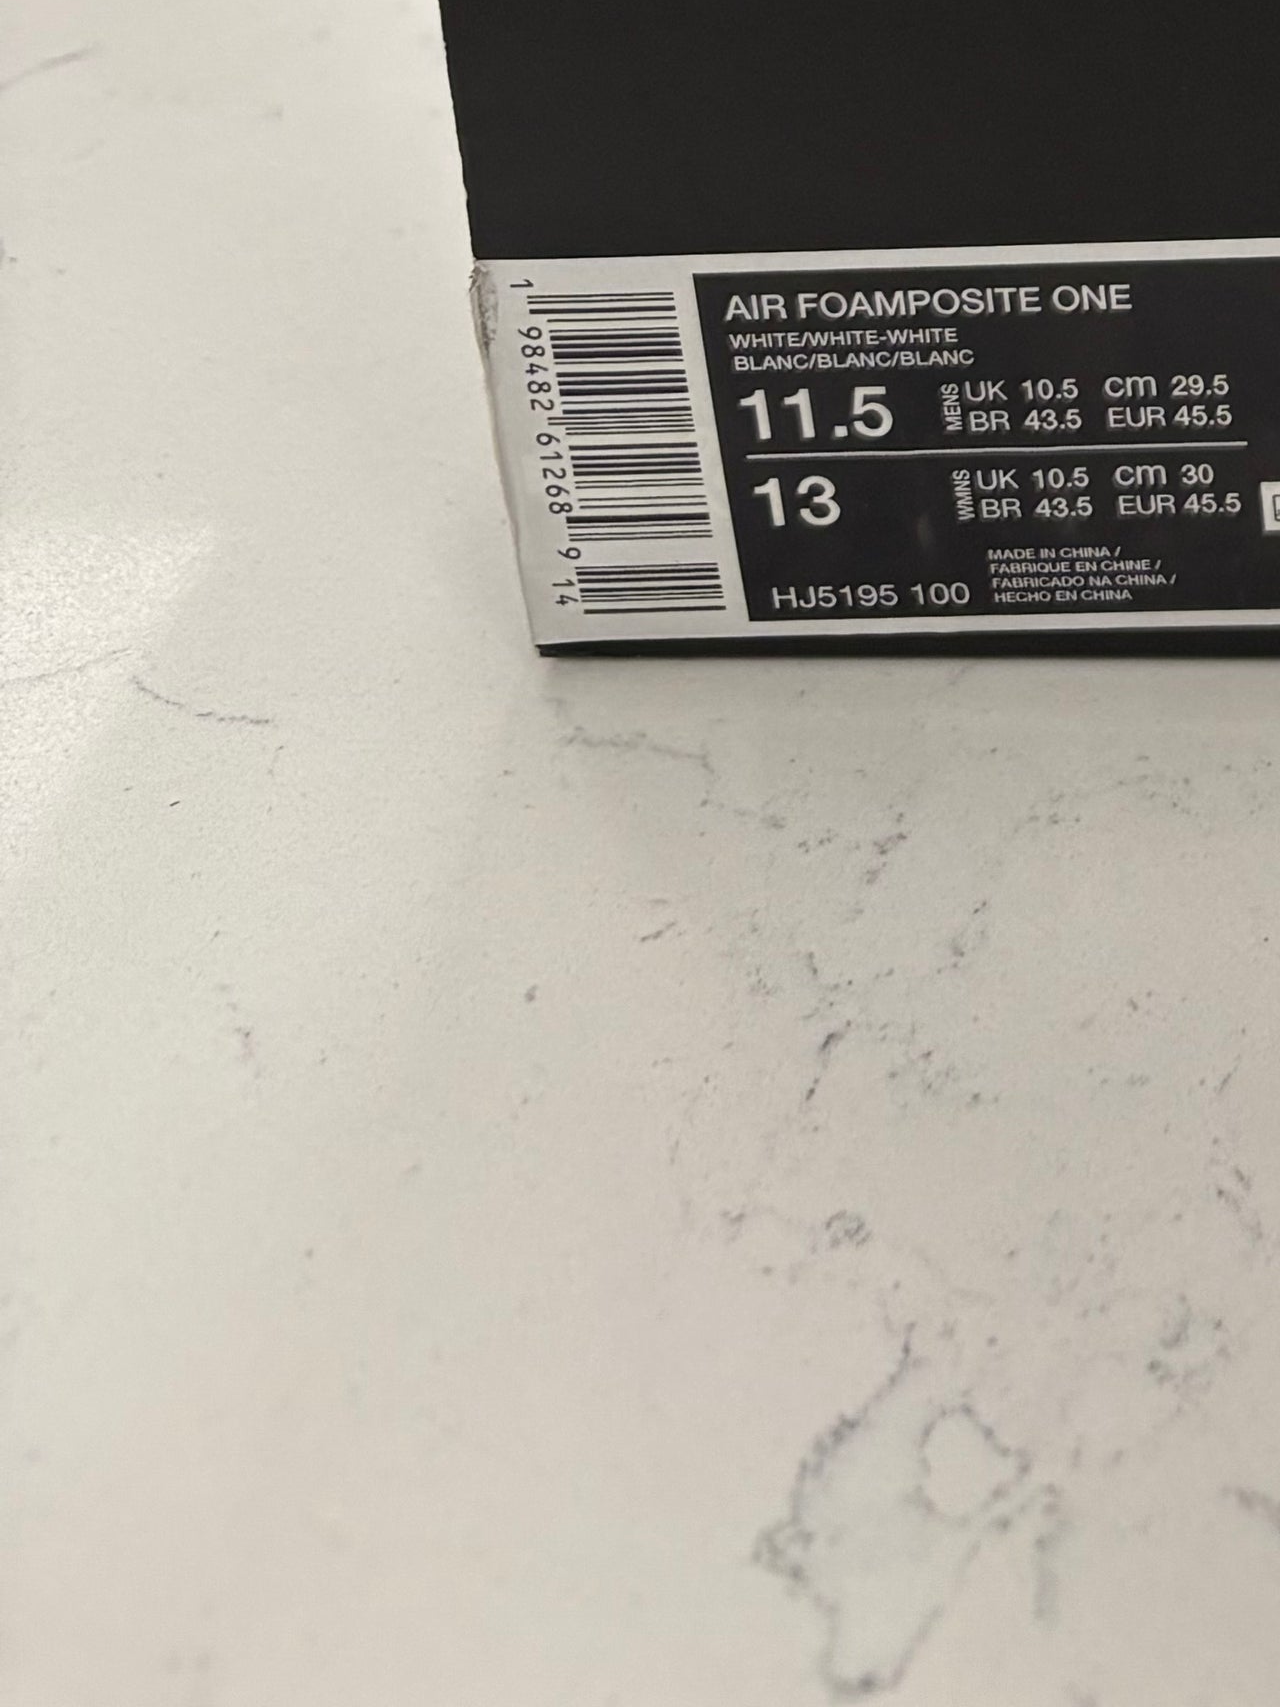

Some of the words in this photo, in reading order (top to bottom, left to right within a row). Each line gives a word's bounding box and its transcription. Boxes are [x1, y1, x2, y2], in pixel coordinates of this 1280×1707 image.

[510, 277, 534, 289] 1
[726, 295, 787, 320] AIR
[798, 287, 1041, 318] FOAMPOSITE
[1053, 284, 1132, 311] ONE
[729, 328, 958, 348] WHITE/WHITE-WHITE
[518, 325, 555, 412] 98482
[734, 350, 974, 371] BLANC/BLANC/BLANC
[965, 381, 1007, 401] UK
[1022, 379, 1078, 400] 10.5
[1105, 376, 1156, 397] cm
[1172, 375, 1229, 396] 29.5
[740, 387, 892, 439] 11.5
[941, 384, 962, 430] MENS
[970, 411, 1010, 431] BR
[1025, 409, 1081, 430] 43.5
[1108, 407, 1166, 427] EUR
[1175, 405, 1232, 426] 45.5
[535, 431, 574, 515] 61268
[977, 469, 1018, 490] UK
[1033, 467, 1089, 488] 10.5
[1115, 465, 1166, 486] cm
[1182, 464, 1213, 484] 30
[754, 476, 840, 526] 13
[953, 470, 975, 520] WMNS
[981, 498, 1021, 518] BR
[1036, 497, 1092, 517] 43.5
[1119, 495, 1175, 514] EUR
[1184, 493, 1241, 513] 45.5
[557, 546, 582, 561] 9
[988, 548, 1035, 560] MADE
[1040, 548, 1055, 558] IN
[1060, 547, 1110, 558] CHINA
[991, 562, 1071, 573] FABRIQUE
[1076, 562, 1097, 572] EN
[1101, 560, 1151, 571] CHINE
[551, 576, 580, 606] 14
[993, 576, 1084, 588] FABRICADO
[1089, 576, 1112, 586] NA
[1115, 575, 1166, 585] CHINA
[773, 585, 898, 608] HJ5195
[911, 583, 969, 604] 100
[995, 591, 1051, 602] HECHO
[1056, 590, 1077, 601] EN
[1081, 590, 1132, 600] CHINA
